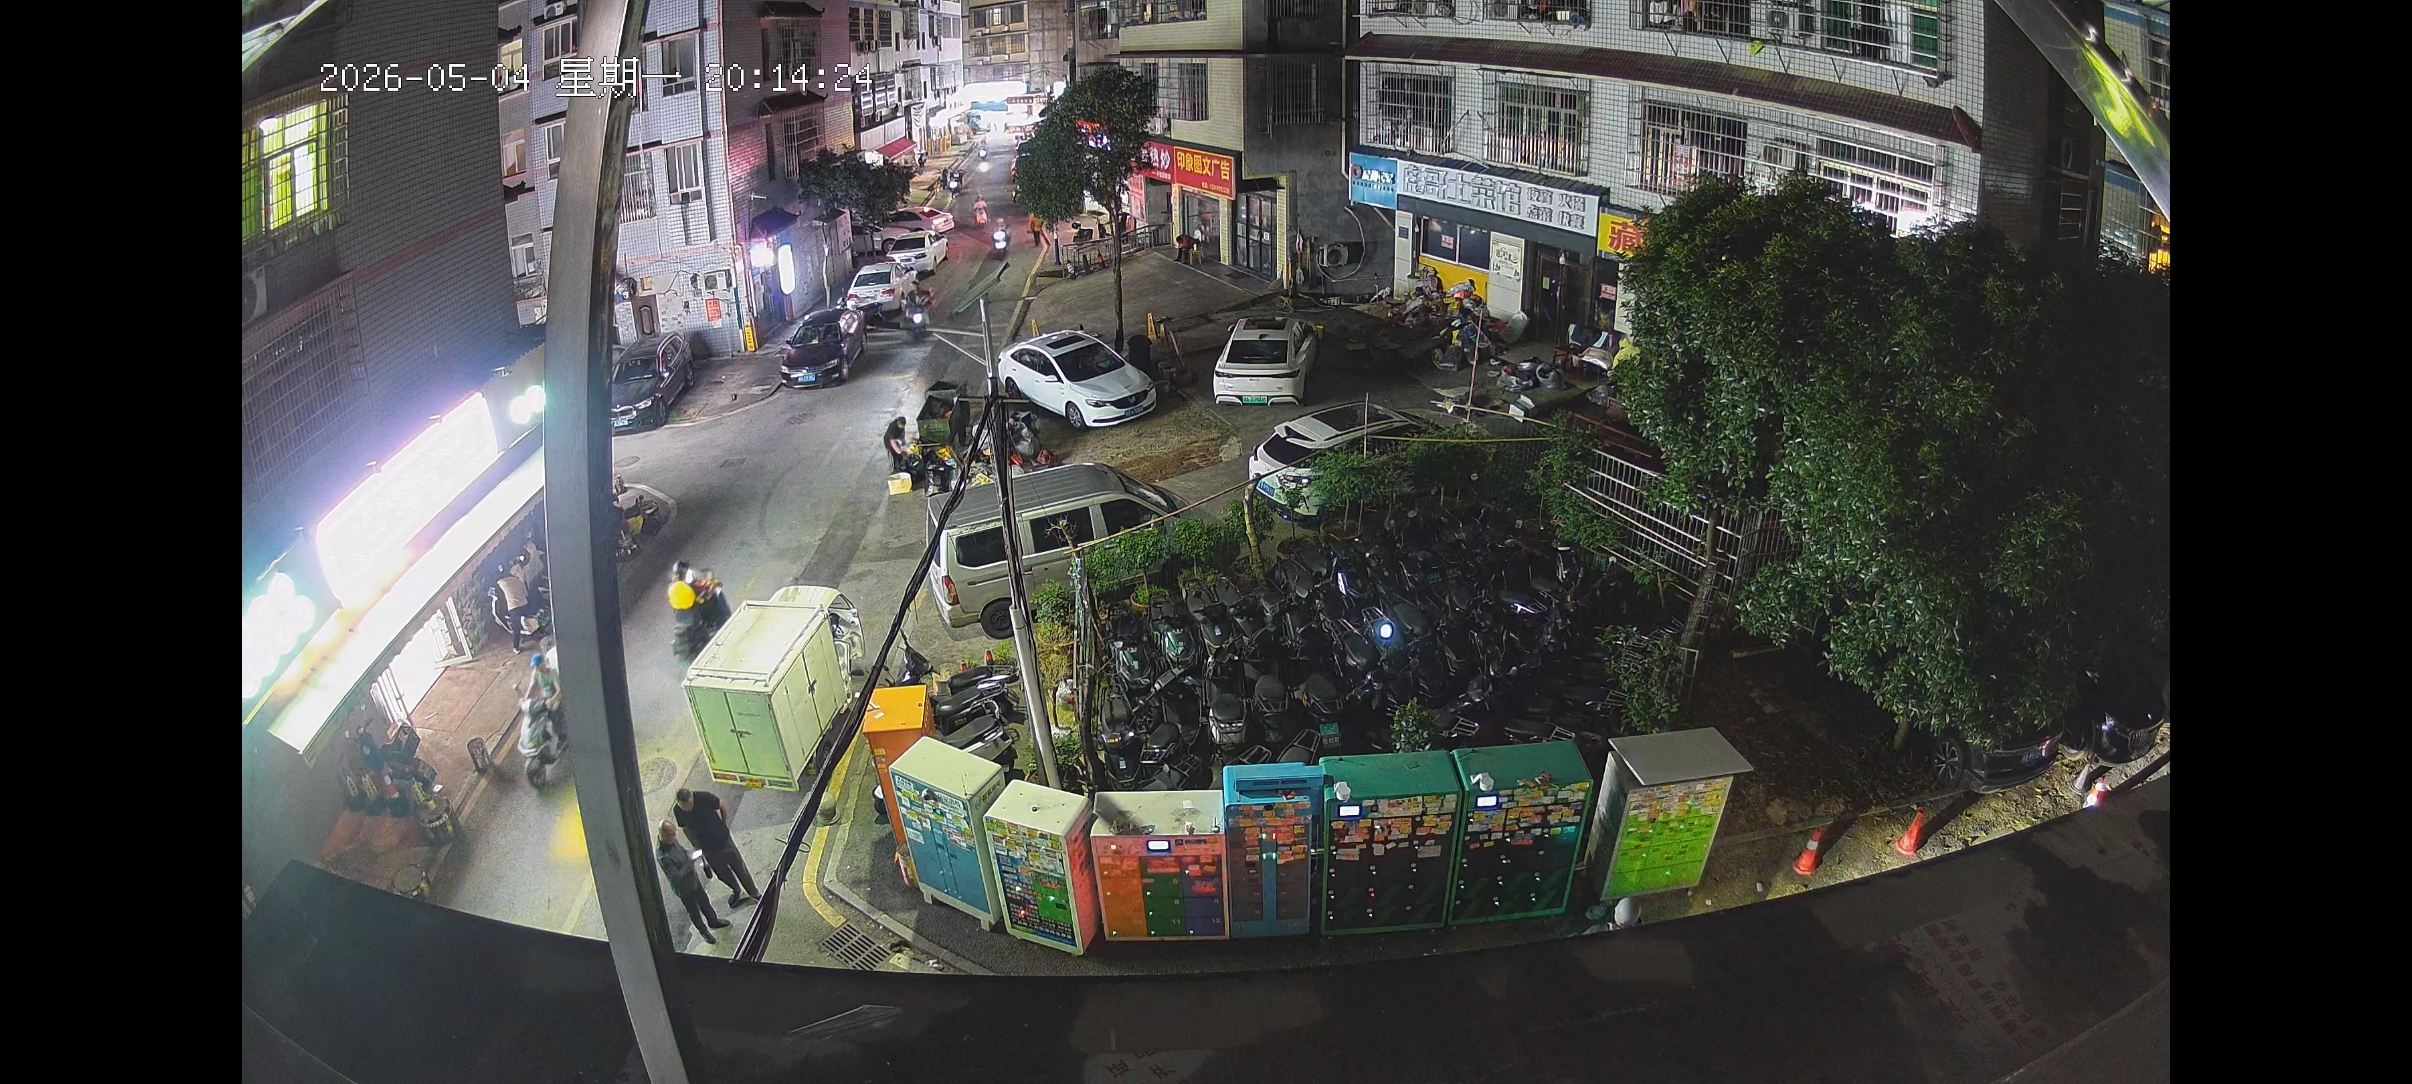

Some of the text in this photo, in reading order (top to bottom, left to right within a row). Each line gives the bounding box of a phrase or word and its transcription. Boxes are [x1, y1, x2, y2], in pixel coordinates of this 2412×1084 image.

[1177, 152, 1230, 181] 印象图文广告
[1557, 193, 1586, 213] 火锅
[1557, 210, 1586, 230] 快餐
